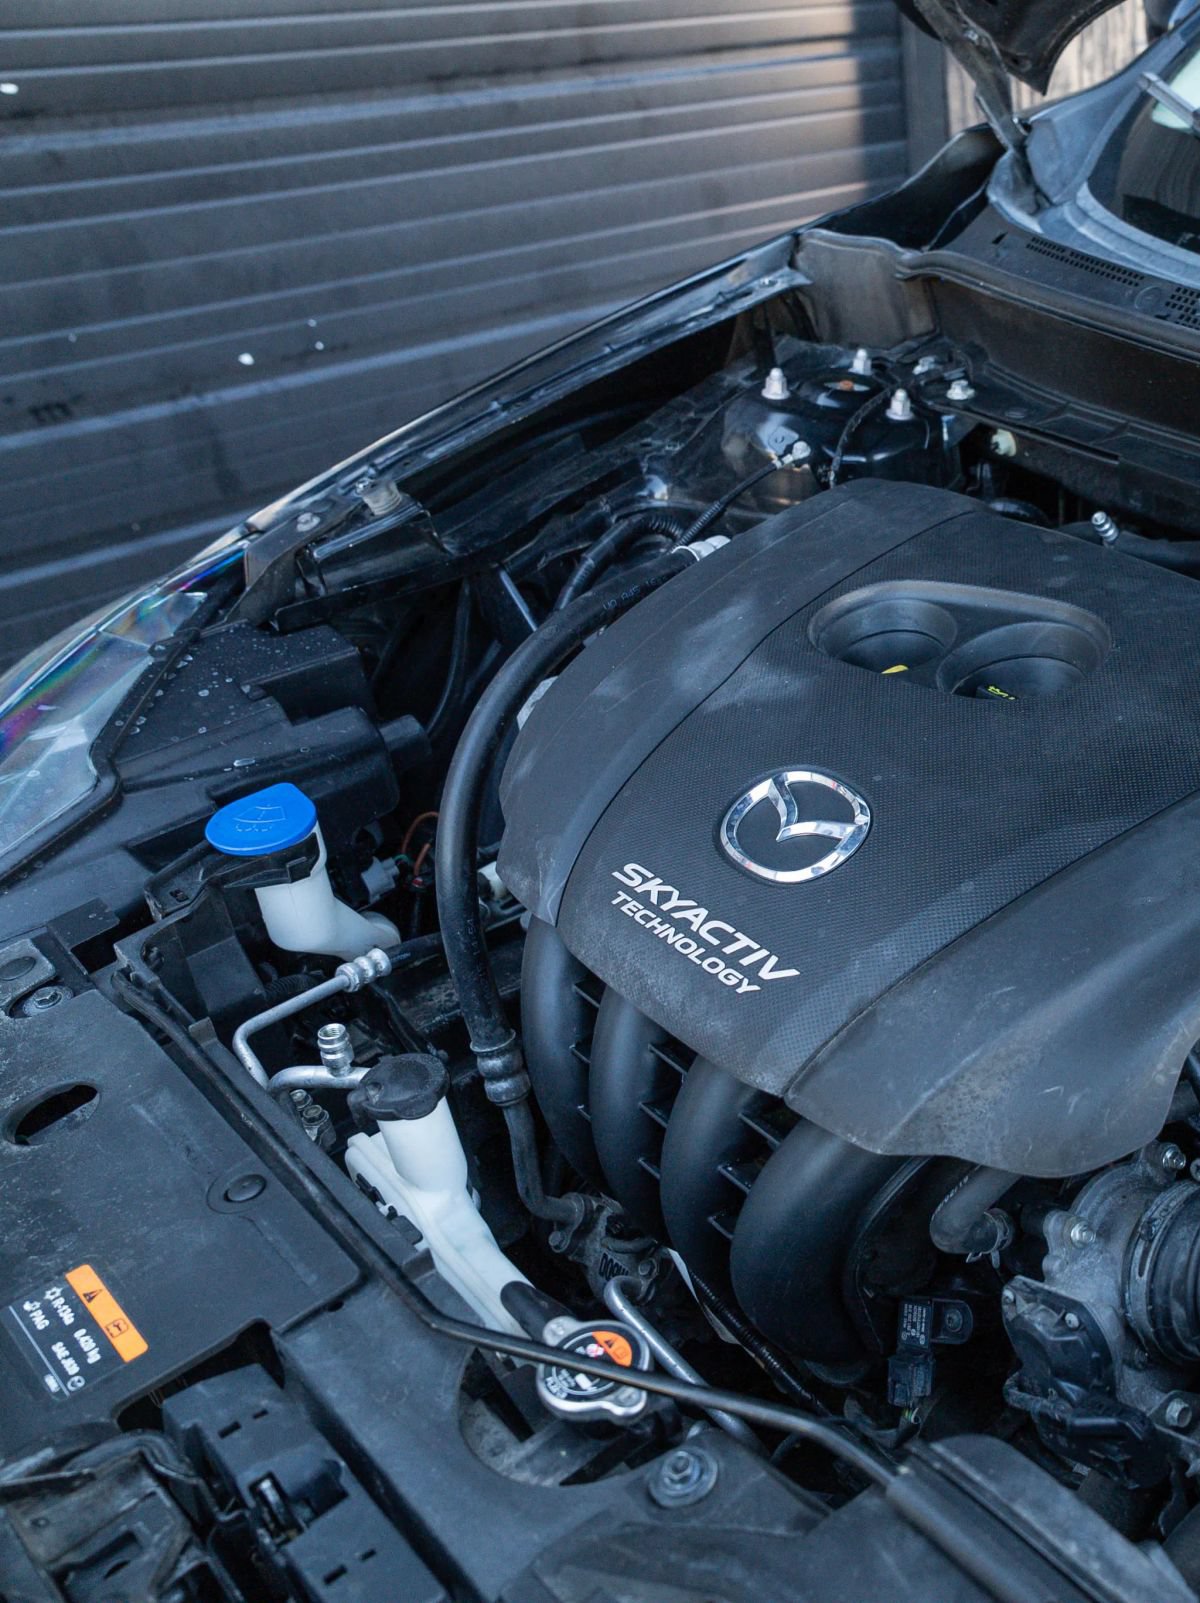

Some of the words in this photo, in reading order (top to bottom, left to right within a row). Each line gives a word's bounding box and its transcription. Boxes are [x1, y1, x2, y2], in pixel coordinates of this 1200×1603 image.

[611, 863, 801, 980] SKYACTIV
[611, 890, 762, 994] TECHNOLOGY
[29, 1309, 50, 1331] PAG
[51, 1341, 70, 1361] SAE
[51, 1297, 75, 1326] R-134a
[86, 1347, 101, 1365] kg
